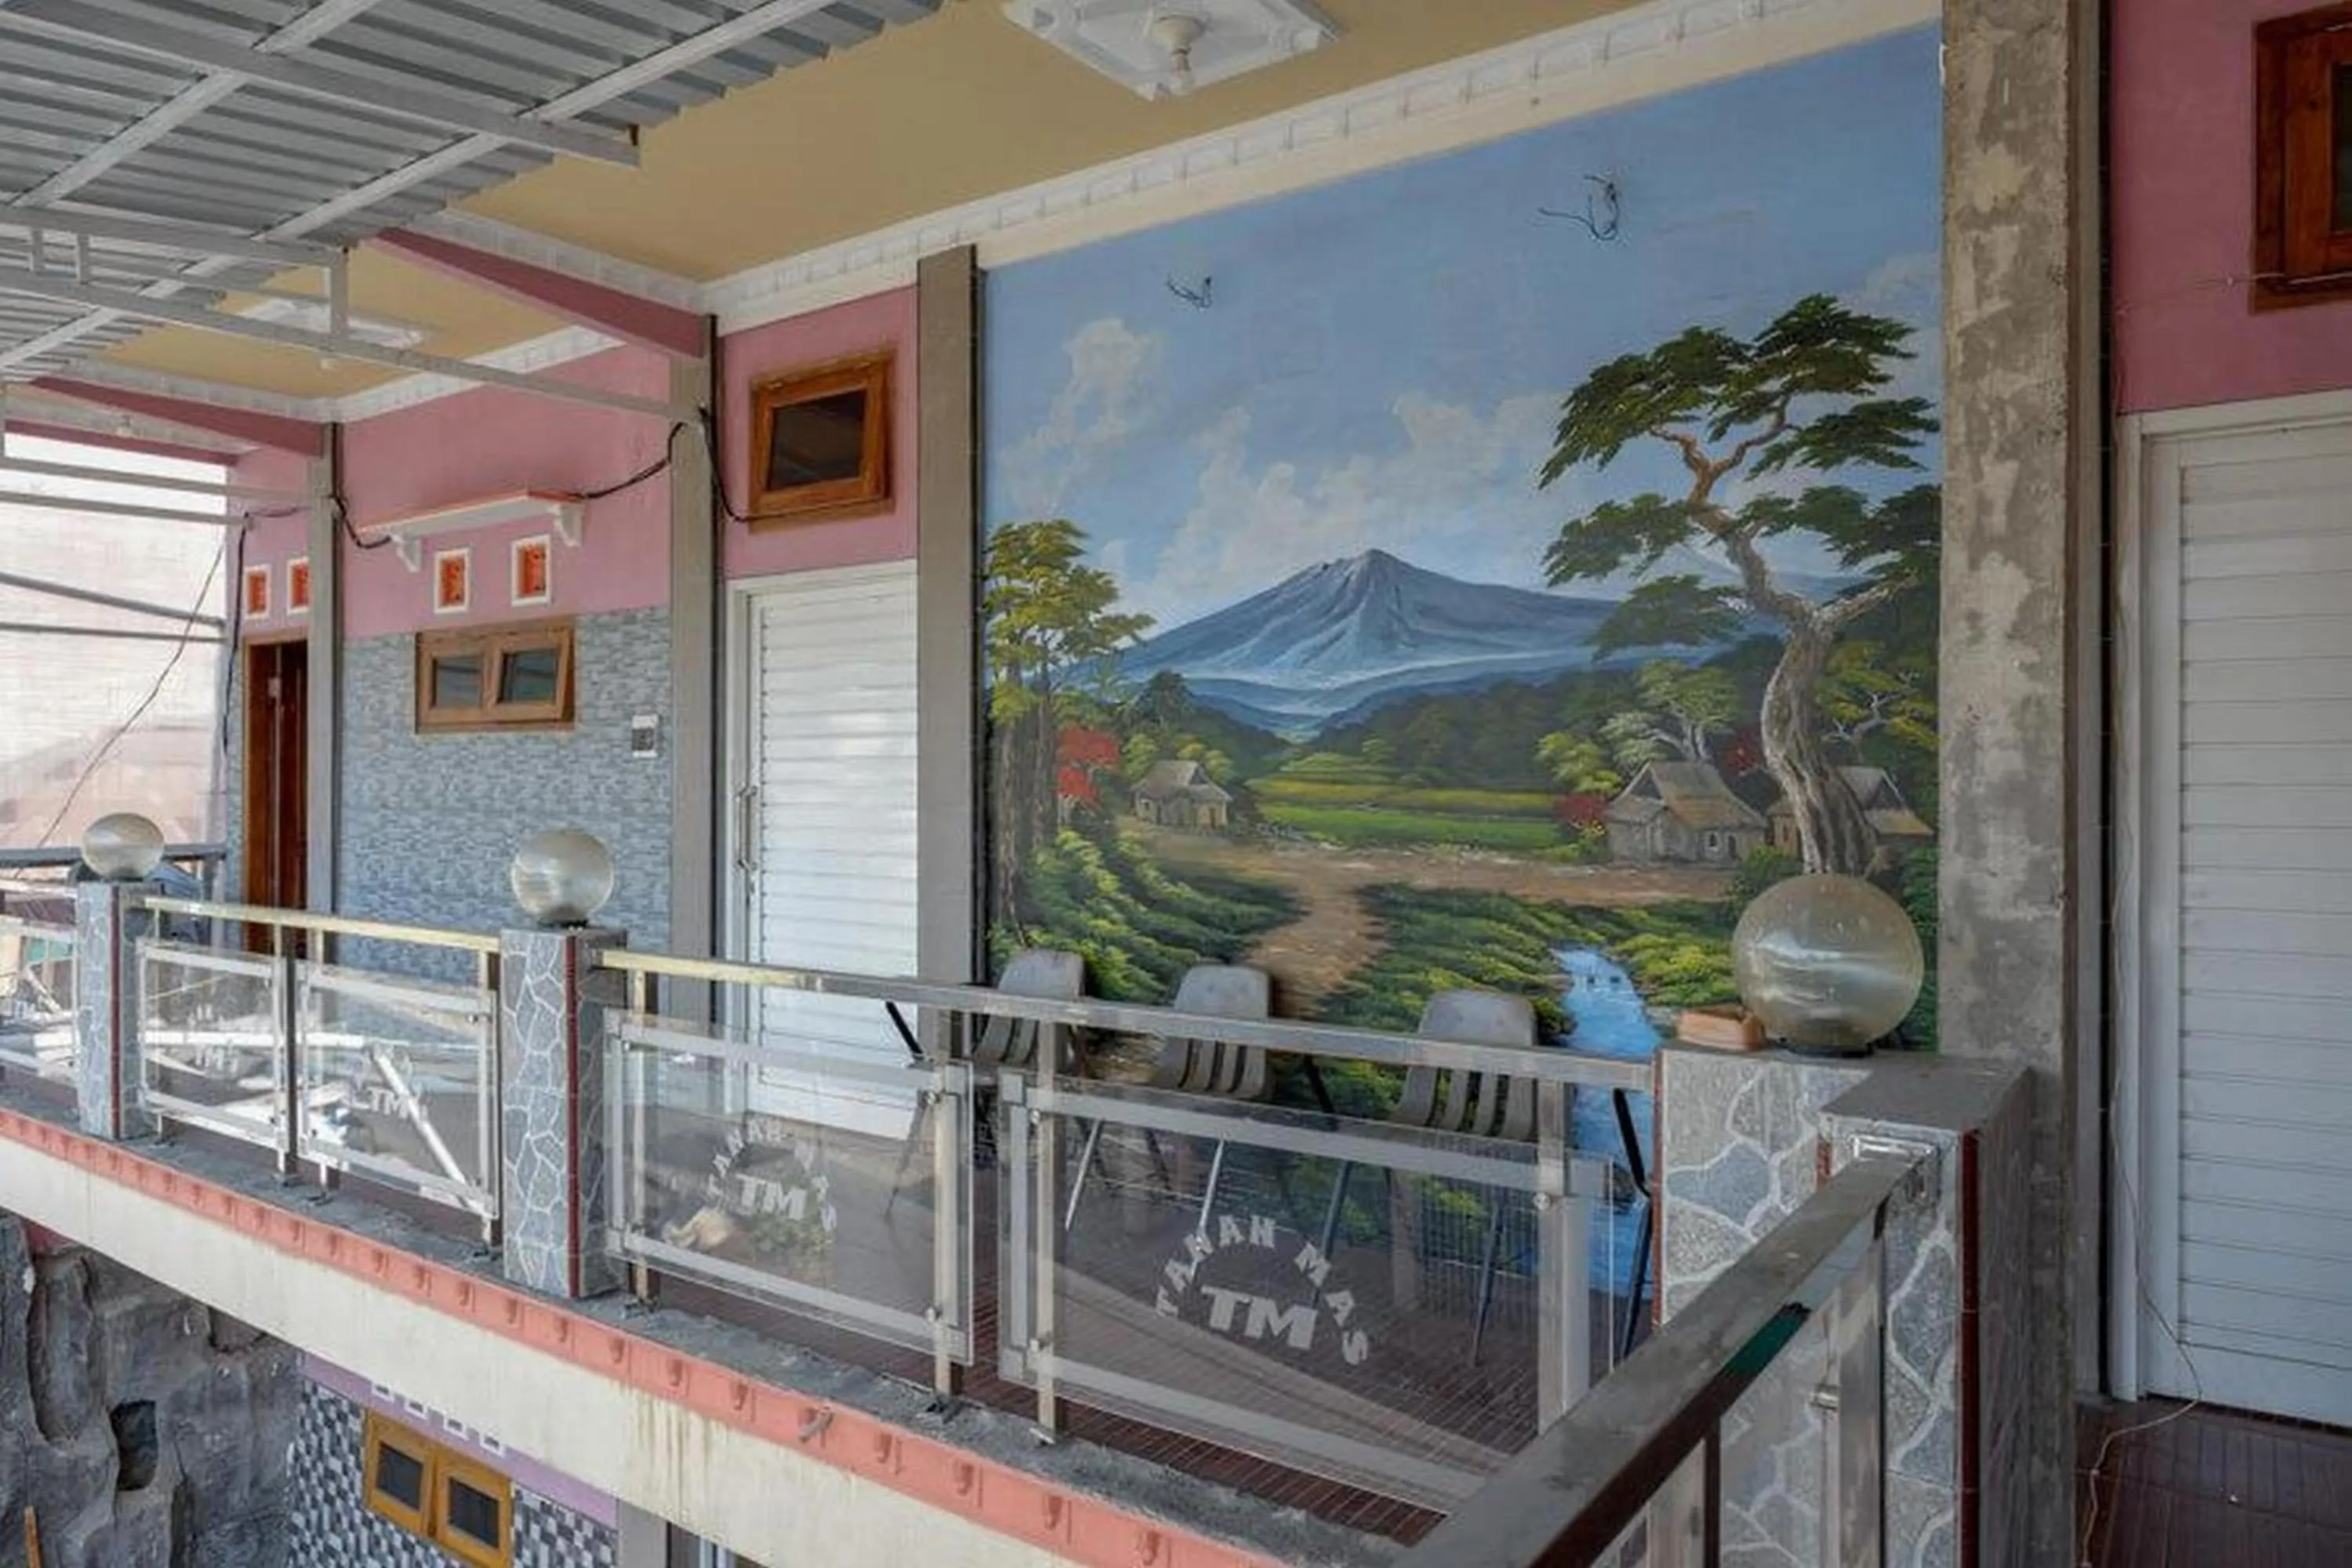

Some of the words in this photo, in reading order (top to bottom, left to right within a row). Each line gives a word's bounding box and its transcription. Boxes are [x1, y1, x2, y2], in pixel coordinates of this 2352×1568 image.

[735, 1173, 807, 1221] TM
[1154, 1214, 1276, 1317] TAMAN
[1294, 1241, 1370, 1366] MAS
[1200, 1285, 1318, 1350] TM
